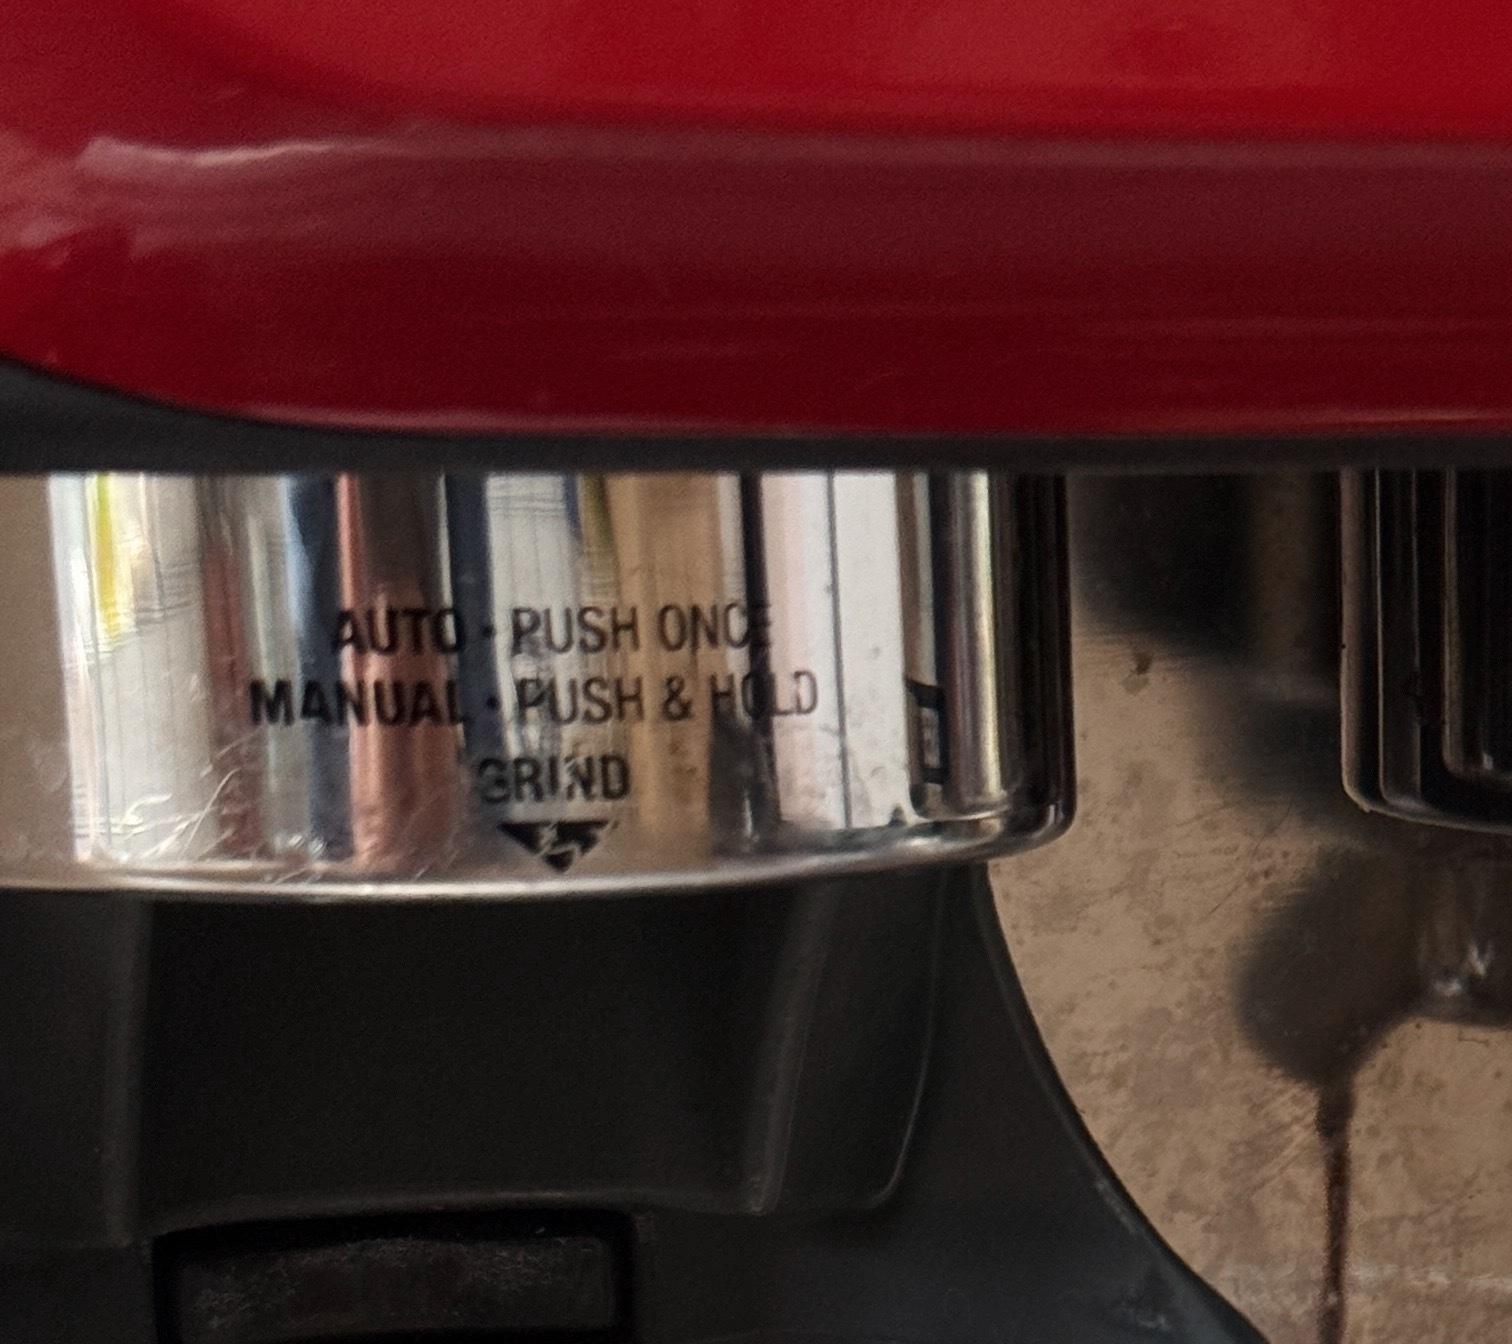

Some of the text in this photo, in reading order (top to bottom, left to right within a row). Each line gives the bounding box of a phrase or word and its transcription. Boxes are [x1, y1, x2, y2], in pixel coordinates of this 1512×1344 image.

[331, 605, 465, 656] AUTO
[511, 604, 639, 657] PUSH
[249, 668, 818, 728] MANUAL PUSH & HOLD
[480, 756, 630, 803] GRIND
